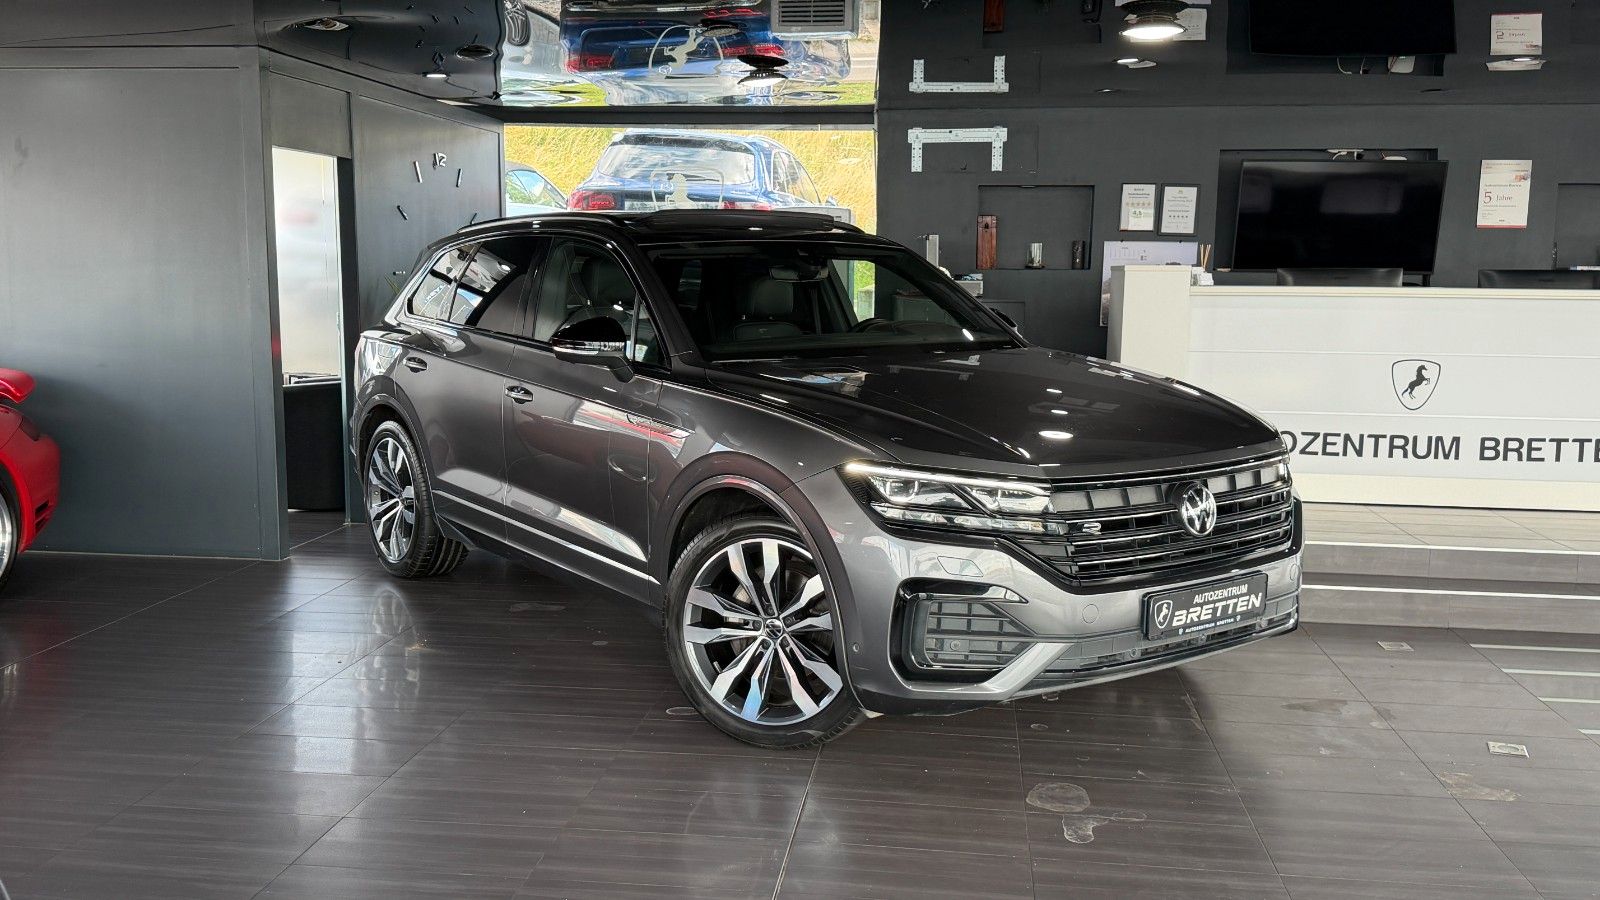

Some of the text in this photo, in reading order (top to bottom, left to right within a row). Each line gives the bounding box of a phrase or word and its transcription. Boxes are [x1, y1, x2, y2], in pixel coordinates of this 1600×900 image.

[433, 152, 447, 167] 12
[1483, 192, 1492, 204] 5
[1193, 583, 1248, 604] AUTOZENTRUM
[1172, 592, 1263, 627] BRETTEN
